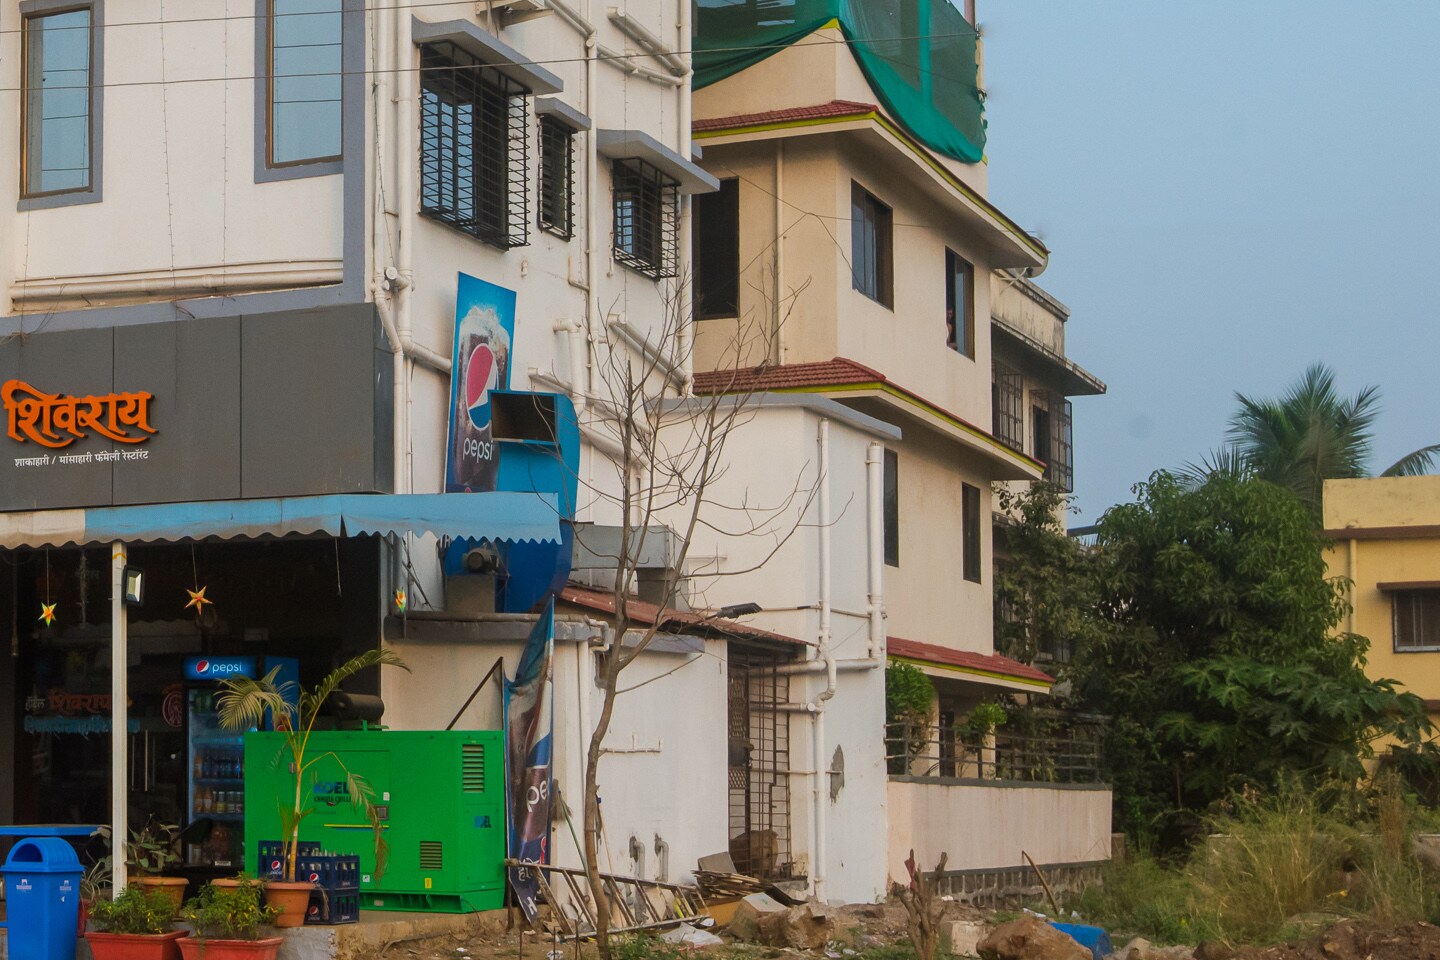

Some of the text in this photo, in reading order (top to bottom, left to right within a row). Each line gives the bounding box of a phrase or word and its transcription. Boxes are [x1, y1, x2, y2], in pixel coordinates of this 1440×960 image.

[0, 379, 160, 448] शिवराय
[462, 436, 493, 464] pepsi
[15, 454, 50, 468] शाकाहारी
[212, 661, 242, 675] pepsi
